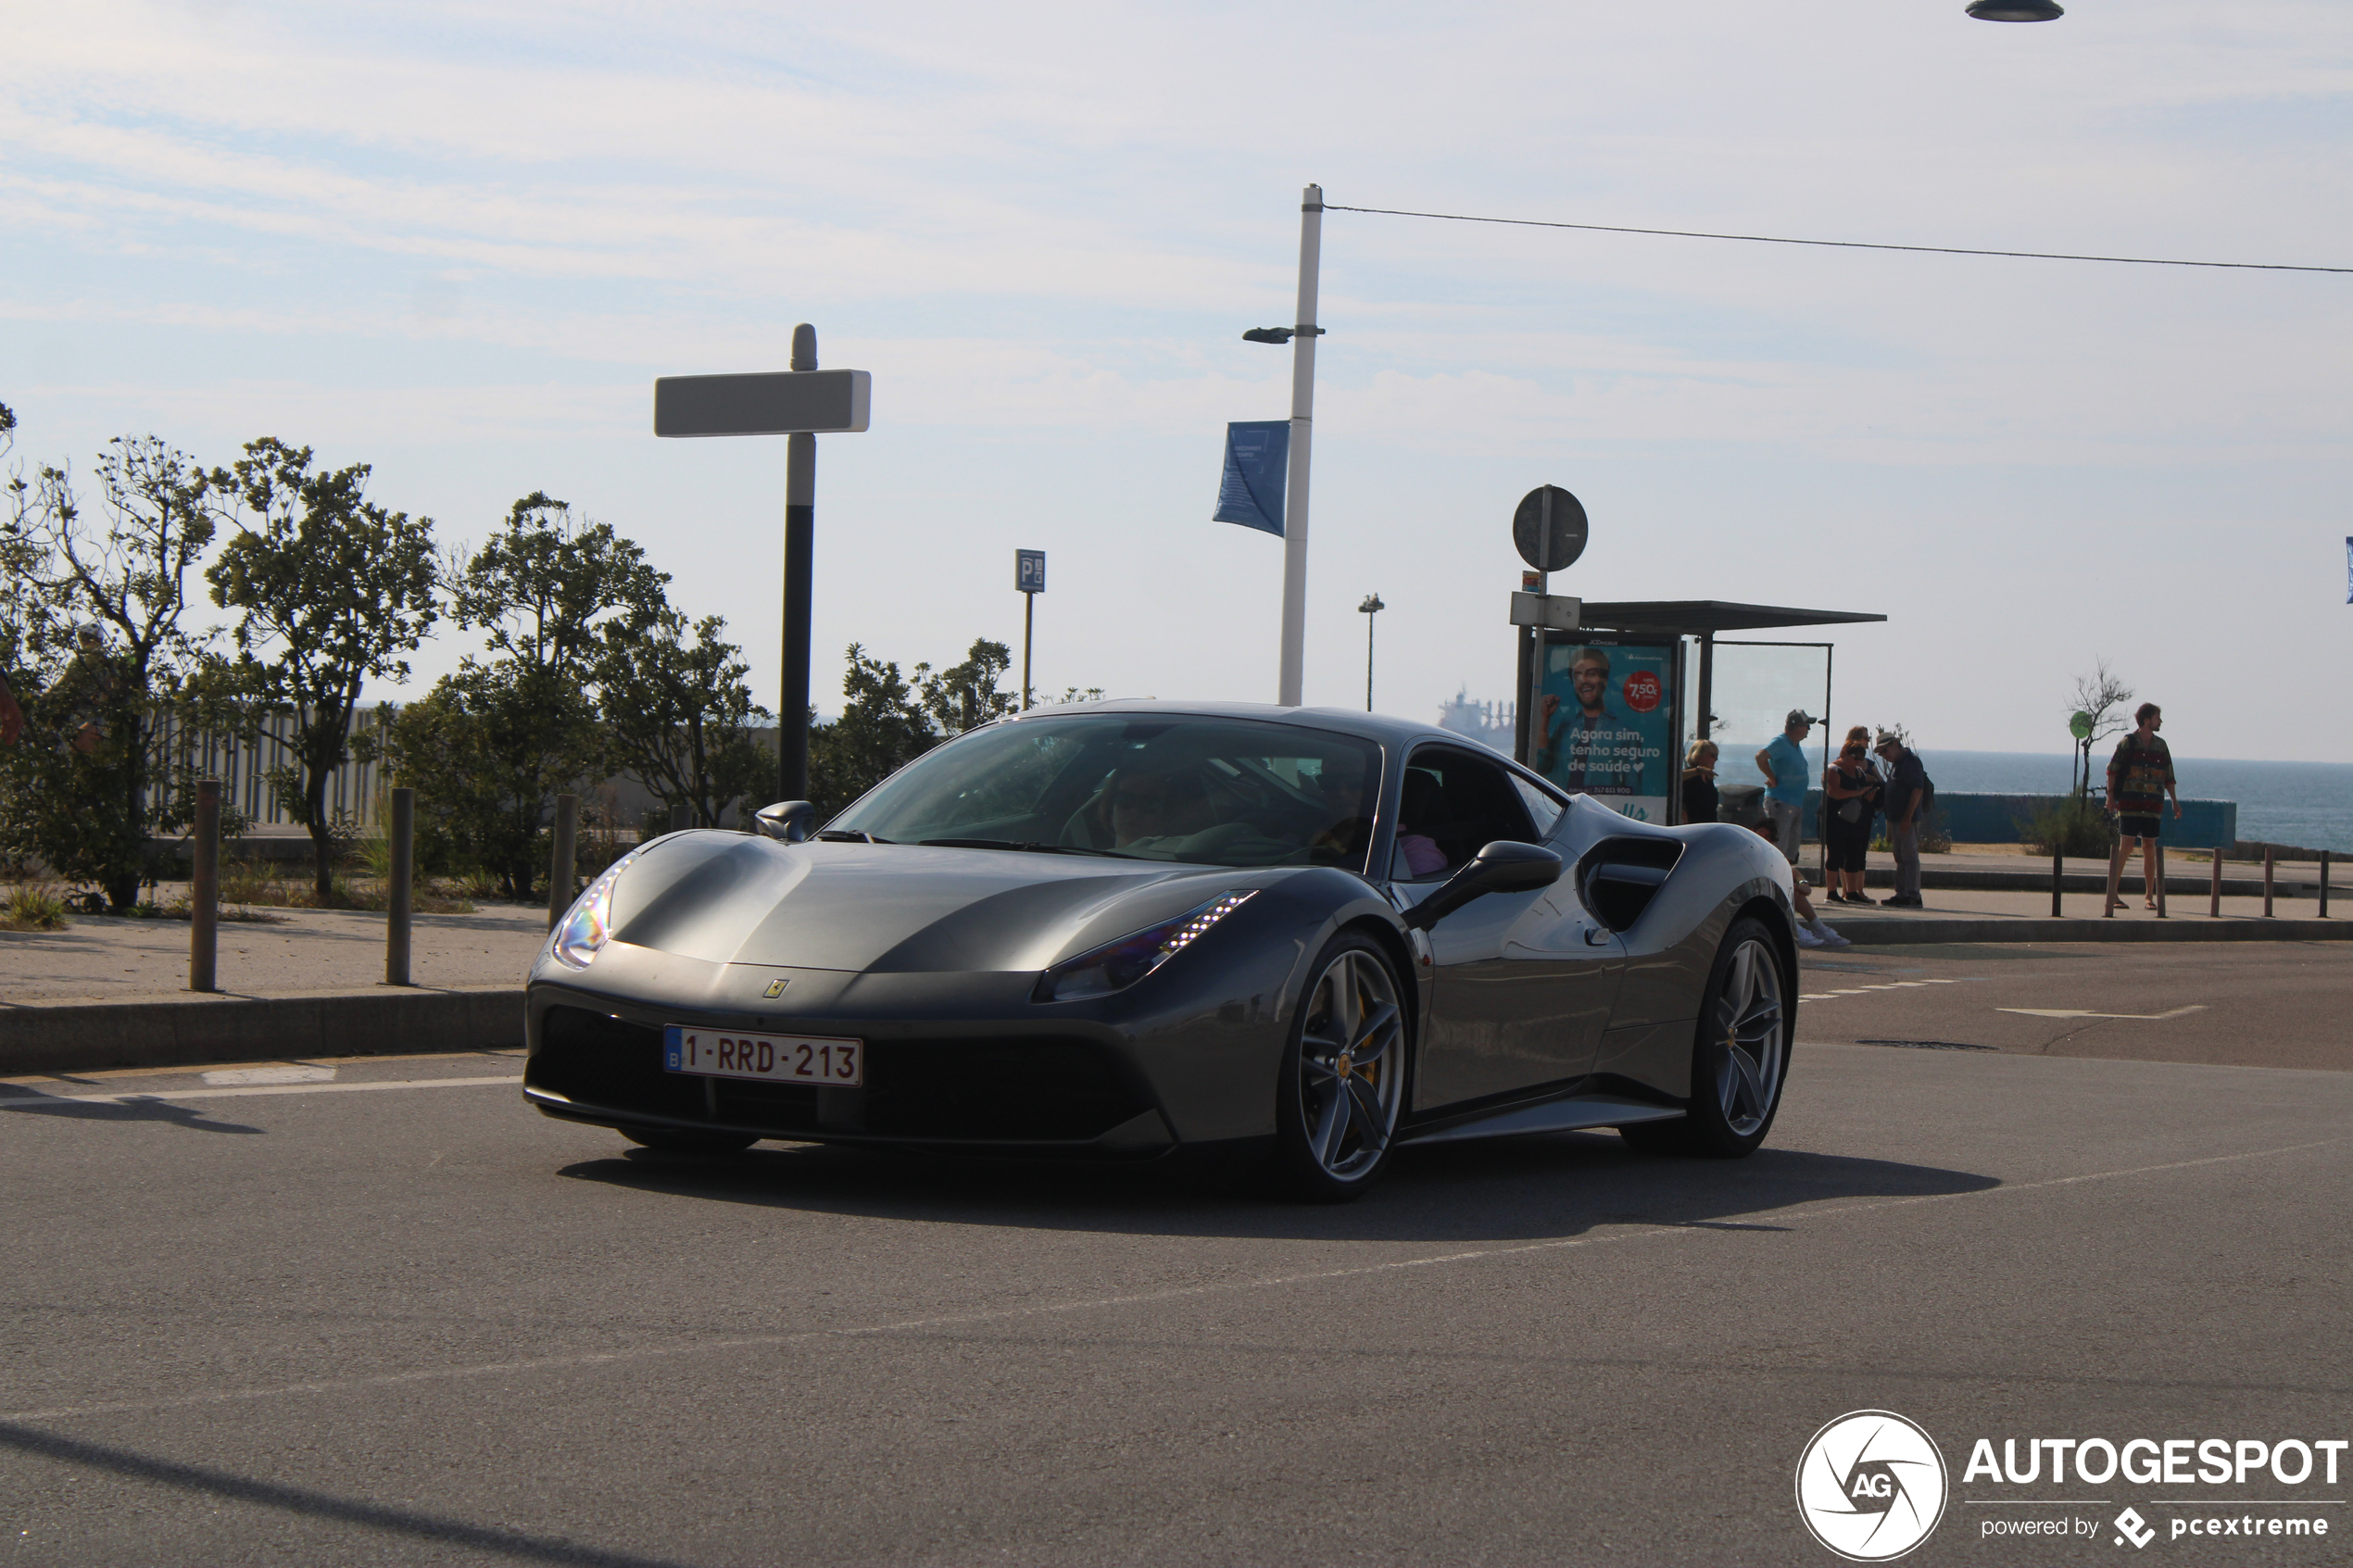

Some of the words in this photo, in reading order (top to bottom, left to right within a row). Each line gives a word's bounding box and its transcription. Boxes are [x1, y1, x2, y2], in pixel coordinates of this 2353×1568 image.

[1022, 560, 1033, 583] P
[1570, 727, 1612, 743] Agora
[1616, 727, 1644, 743] sim,
[1569, 744, 1610, 756] tenho
[1613, 746, 1660, 760] seguro
[1567, 759, 1585, 771] de
[1589, 759, 1630, 772] saúde
[670, 1052, 679, 1067] B
[686, 1035, 855, 1079] 1-RRD-213
